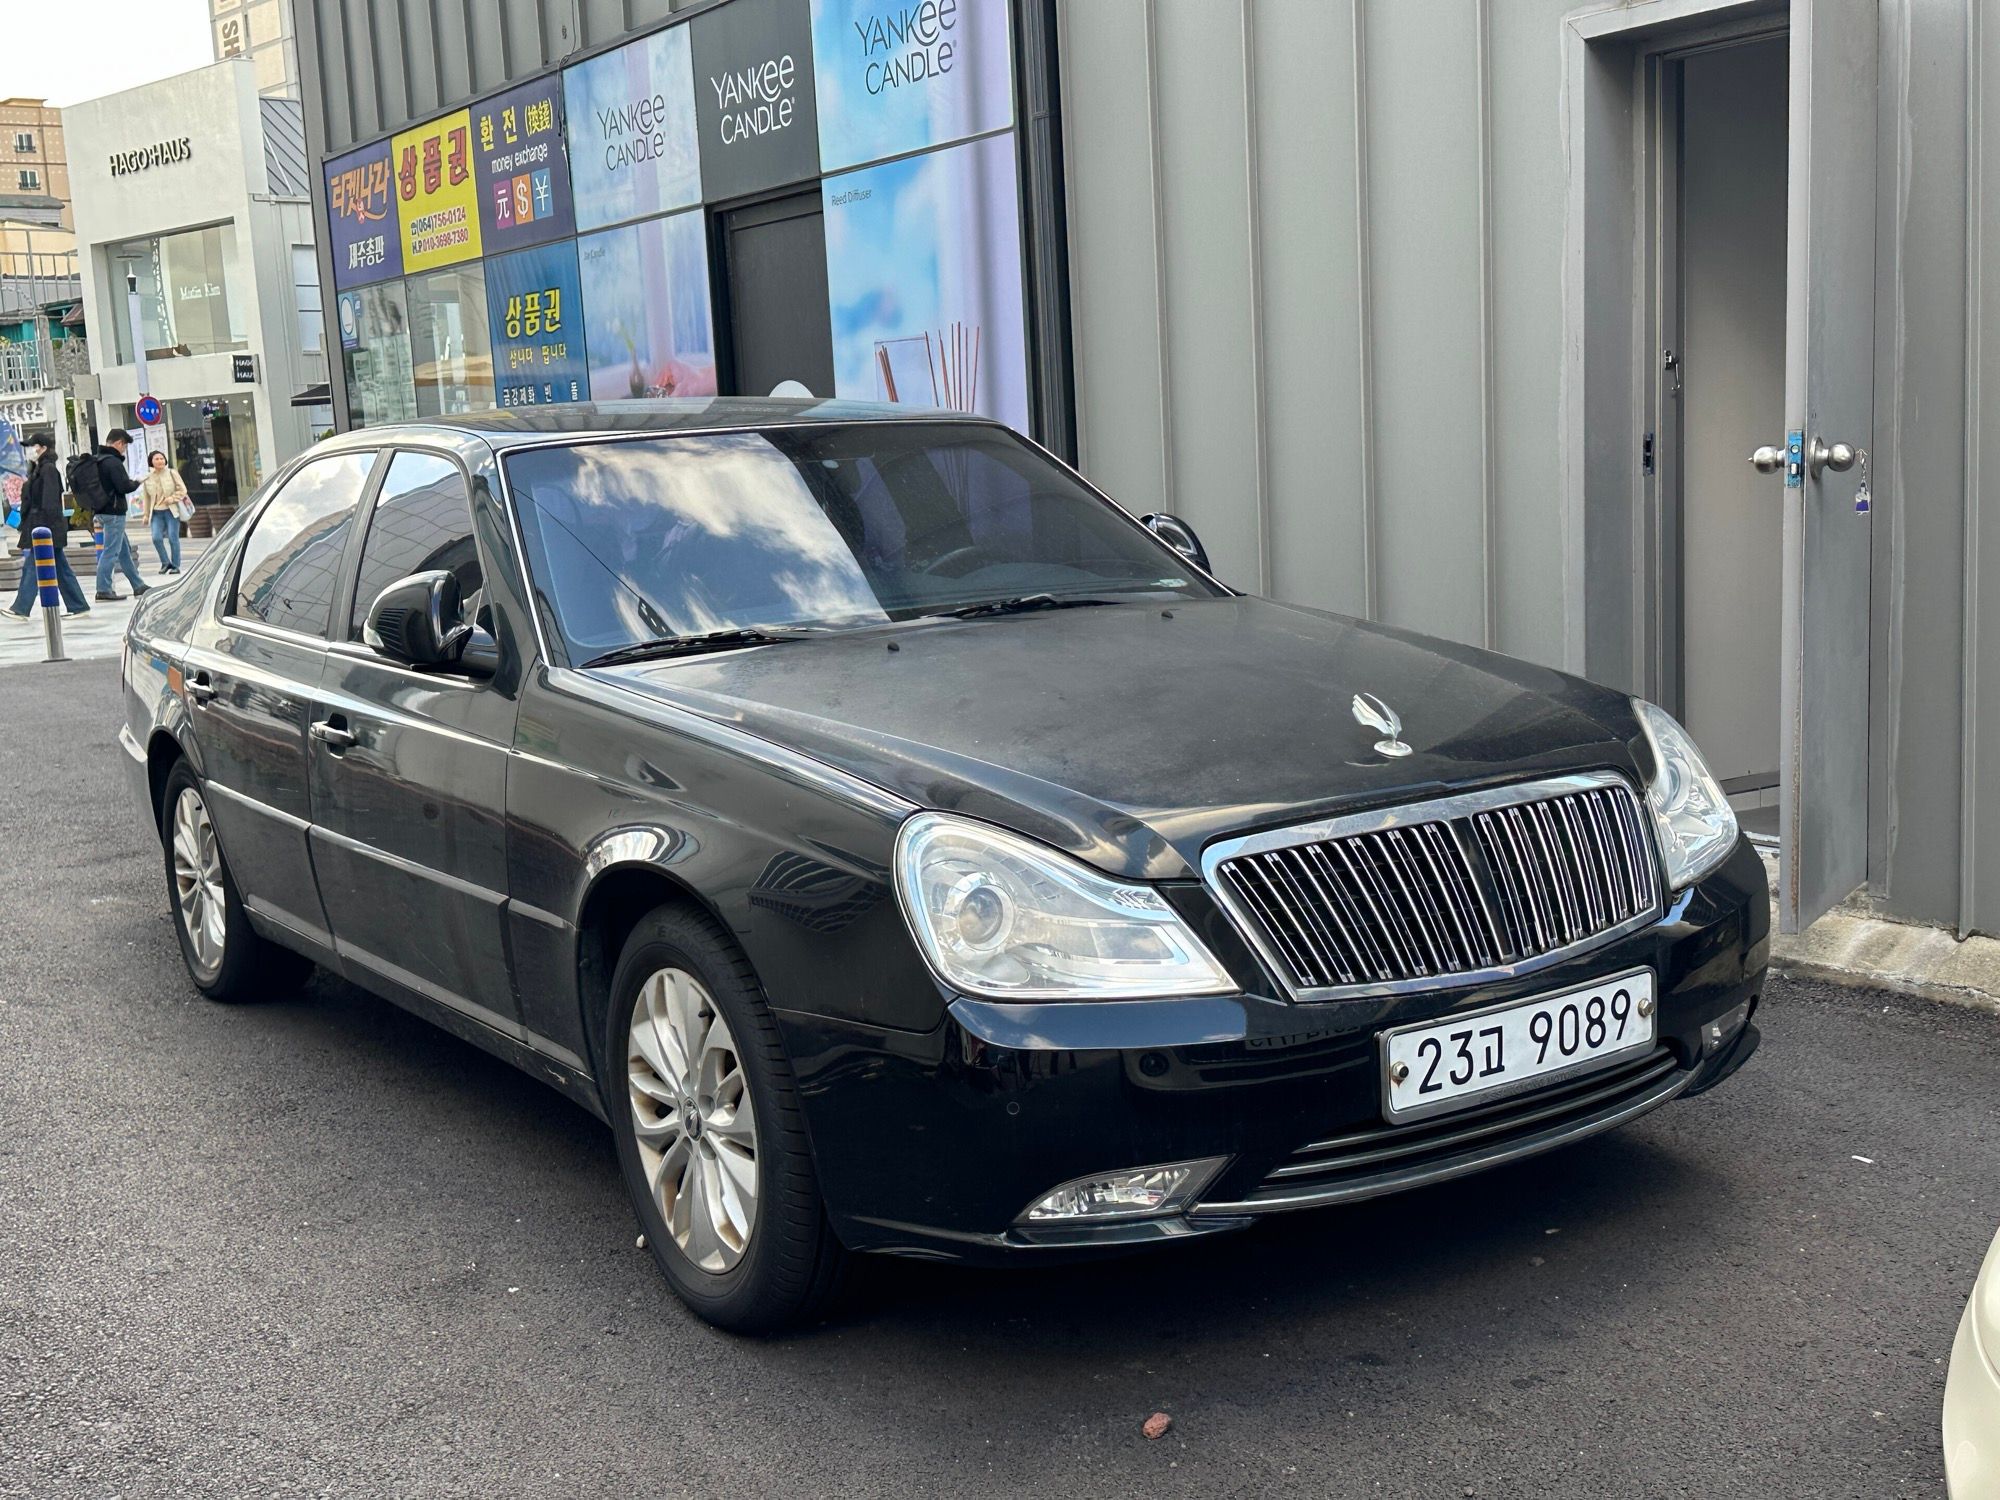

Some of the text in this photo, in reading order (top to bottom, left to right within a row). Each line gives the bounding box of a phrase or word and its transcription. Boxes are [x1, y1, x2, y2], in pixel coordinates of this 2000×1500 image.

[398, 125, 470, 202] 상품권
[491, 142, 549, 174] money exchange
[505, 288, 562, 338] 상품권
[1416, 988, 1632, 1095] 23고 9089
